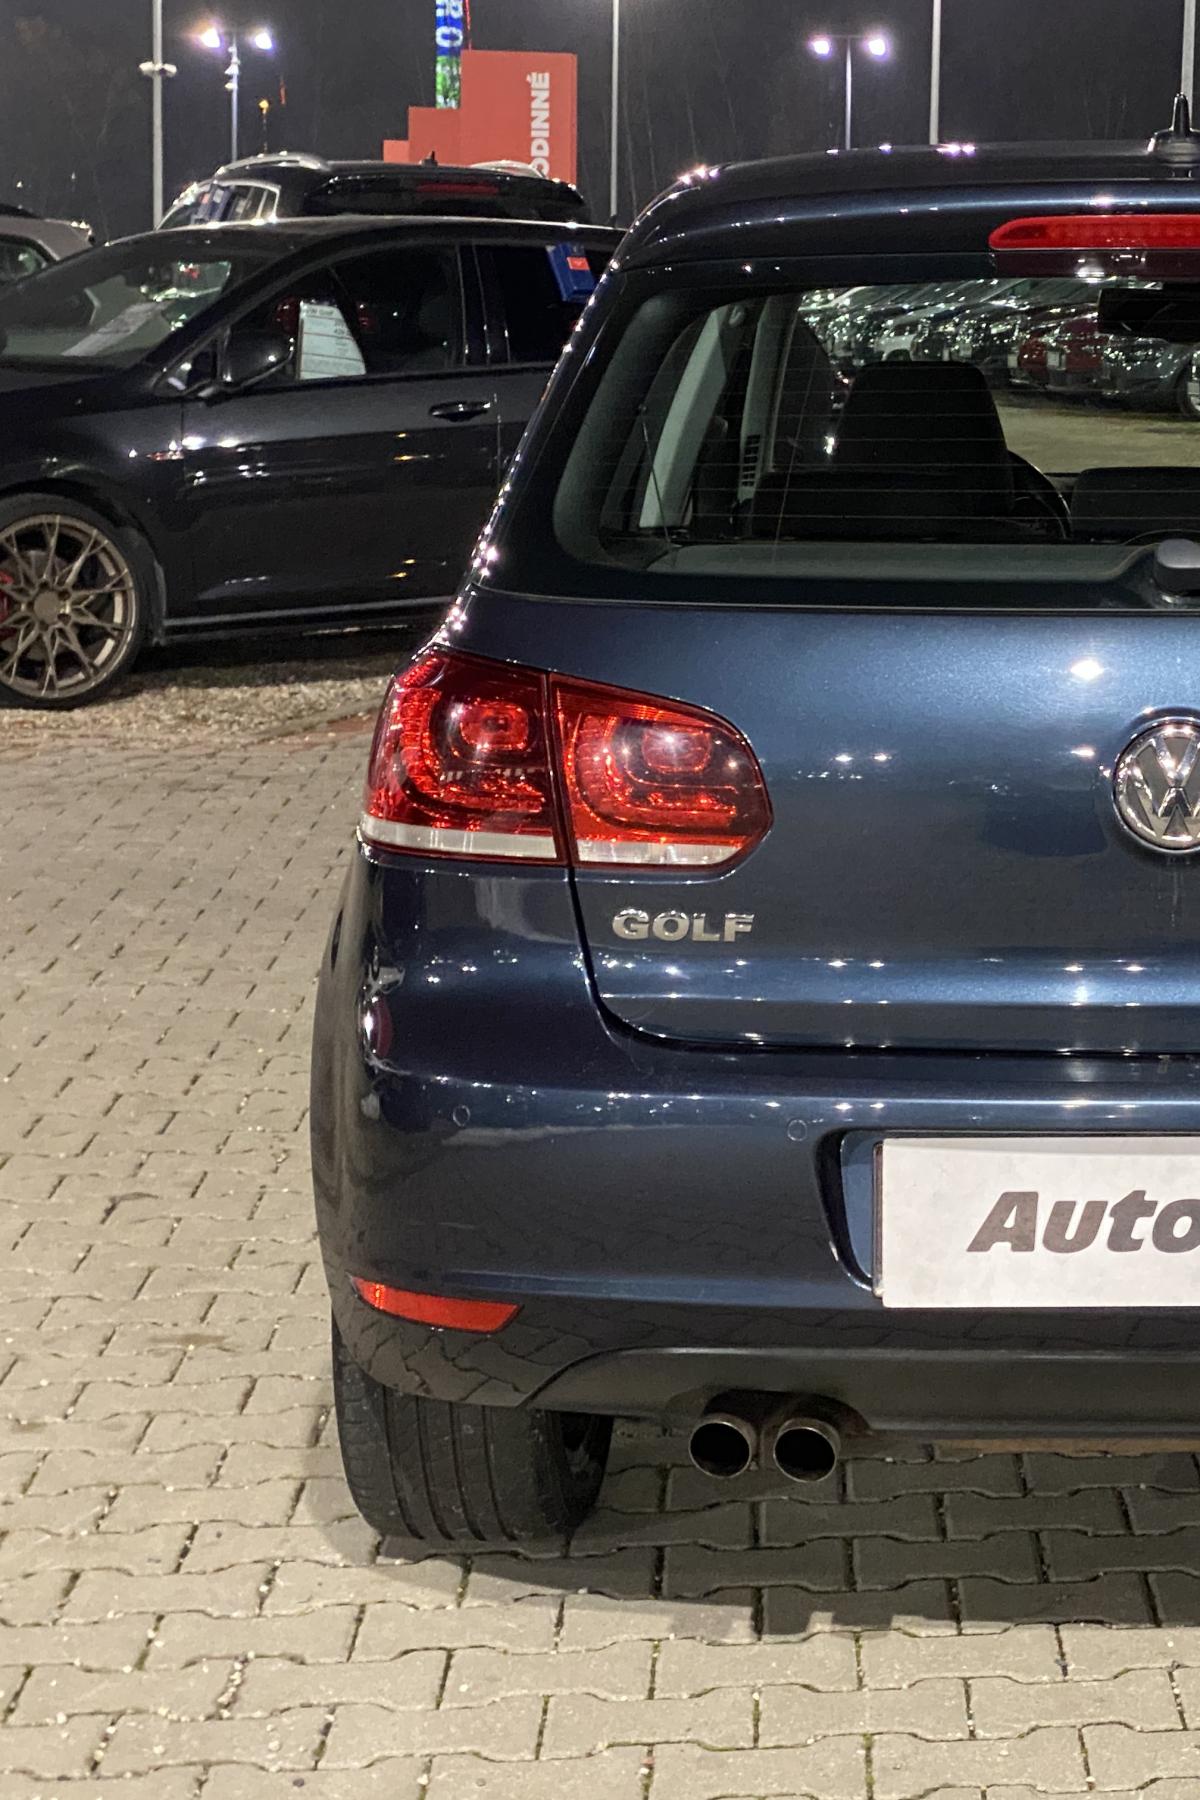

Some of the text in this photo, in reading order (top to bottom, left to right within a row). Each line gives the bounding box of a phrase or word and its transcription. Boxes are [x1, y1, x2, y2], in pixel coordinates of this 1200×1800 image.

[435, 0, 463, 48] RO
[526, 71, 550, 178] ODINNÉ
[612, 908, 755, 943] GOLF
